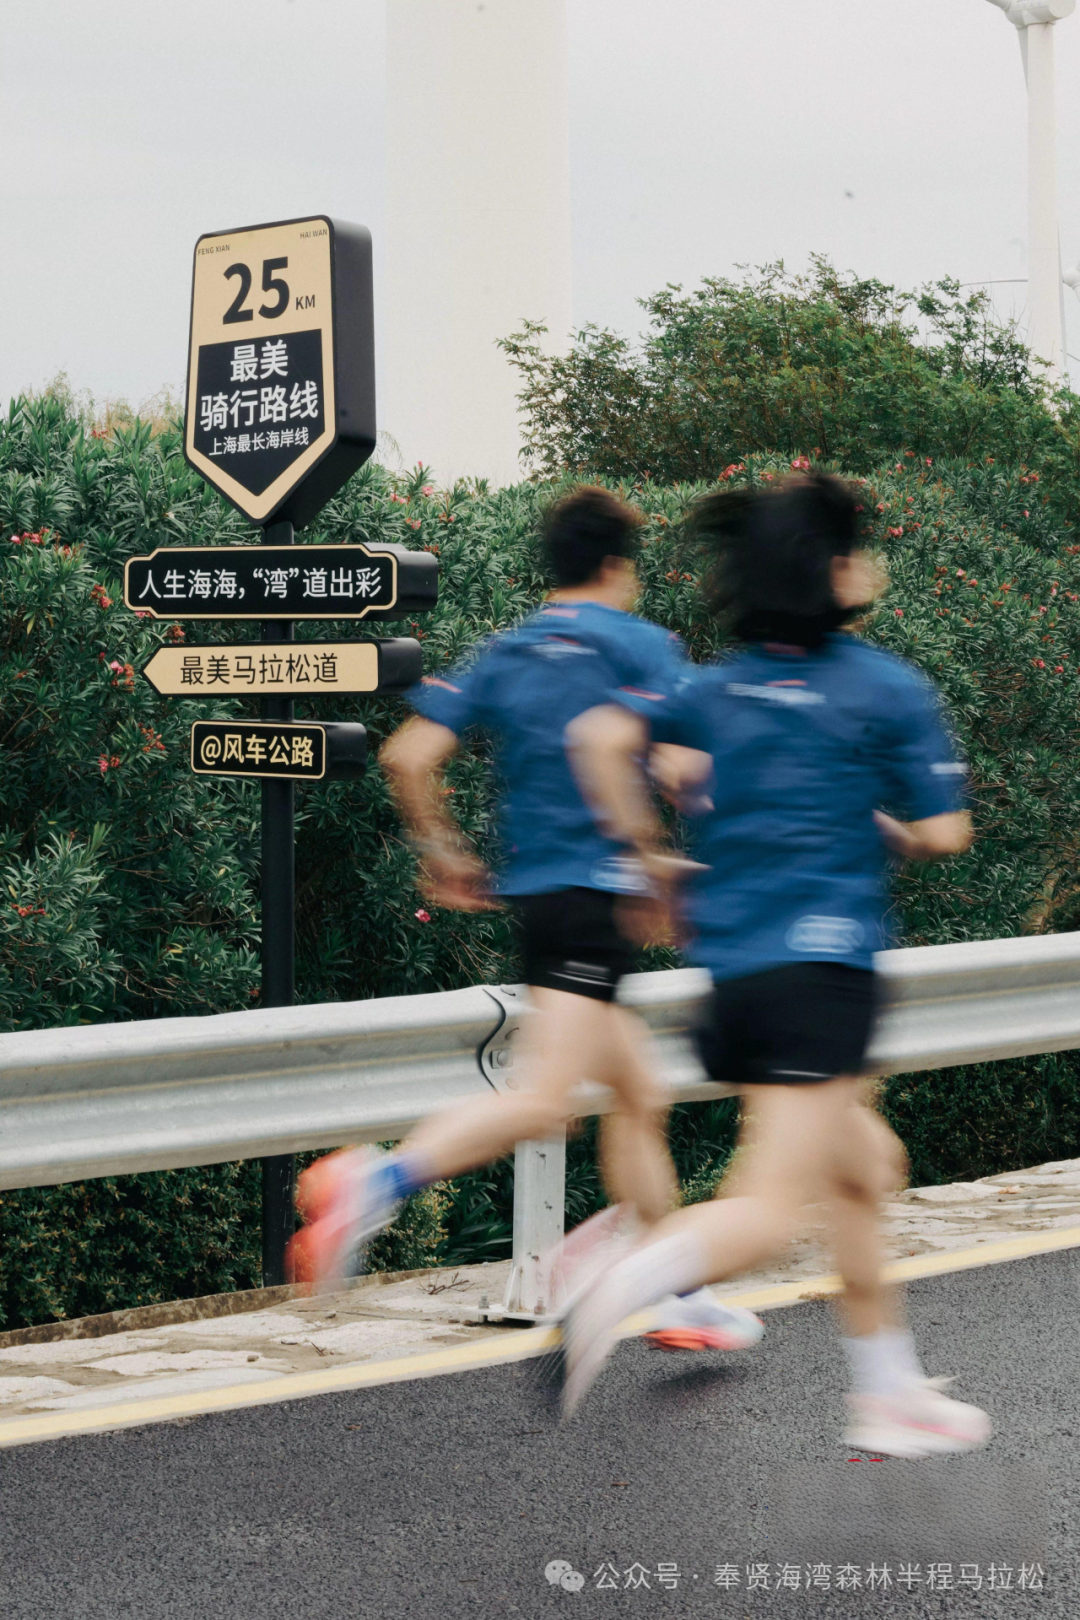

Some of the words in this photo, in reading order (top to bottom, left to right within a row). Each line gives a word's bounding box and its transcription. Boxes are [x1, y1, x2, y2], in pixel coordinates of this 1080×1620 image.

[197, 246, 214, 256] FENG
[215, 244, 231, 253] XIAN
[299, 230, 312, 239] HAI
[312, 228, 328, 237] WAN
[222, 256, 290, 325] 25
[295, 294, 316, 311] KM
[229, 339, 289, 383] 最美
[200, 380, 319, 432] 骑行路线
[208, 426, 309, 456] 上海最长海岸线
[180, 652, 339, 686] 最美马拉松道
[200, 734, 314, 767] @风车公路
